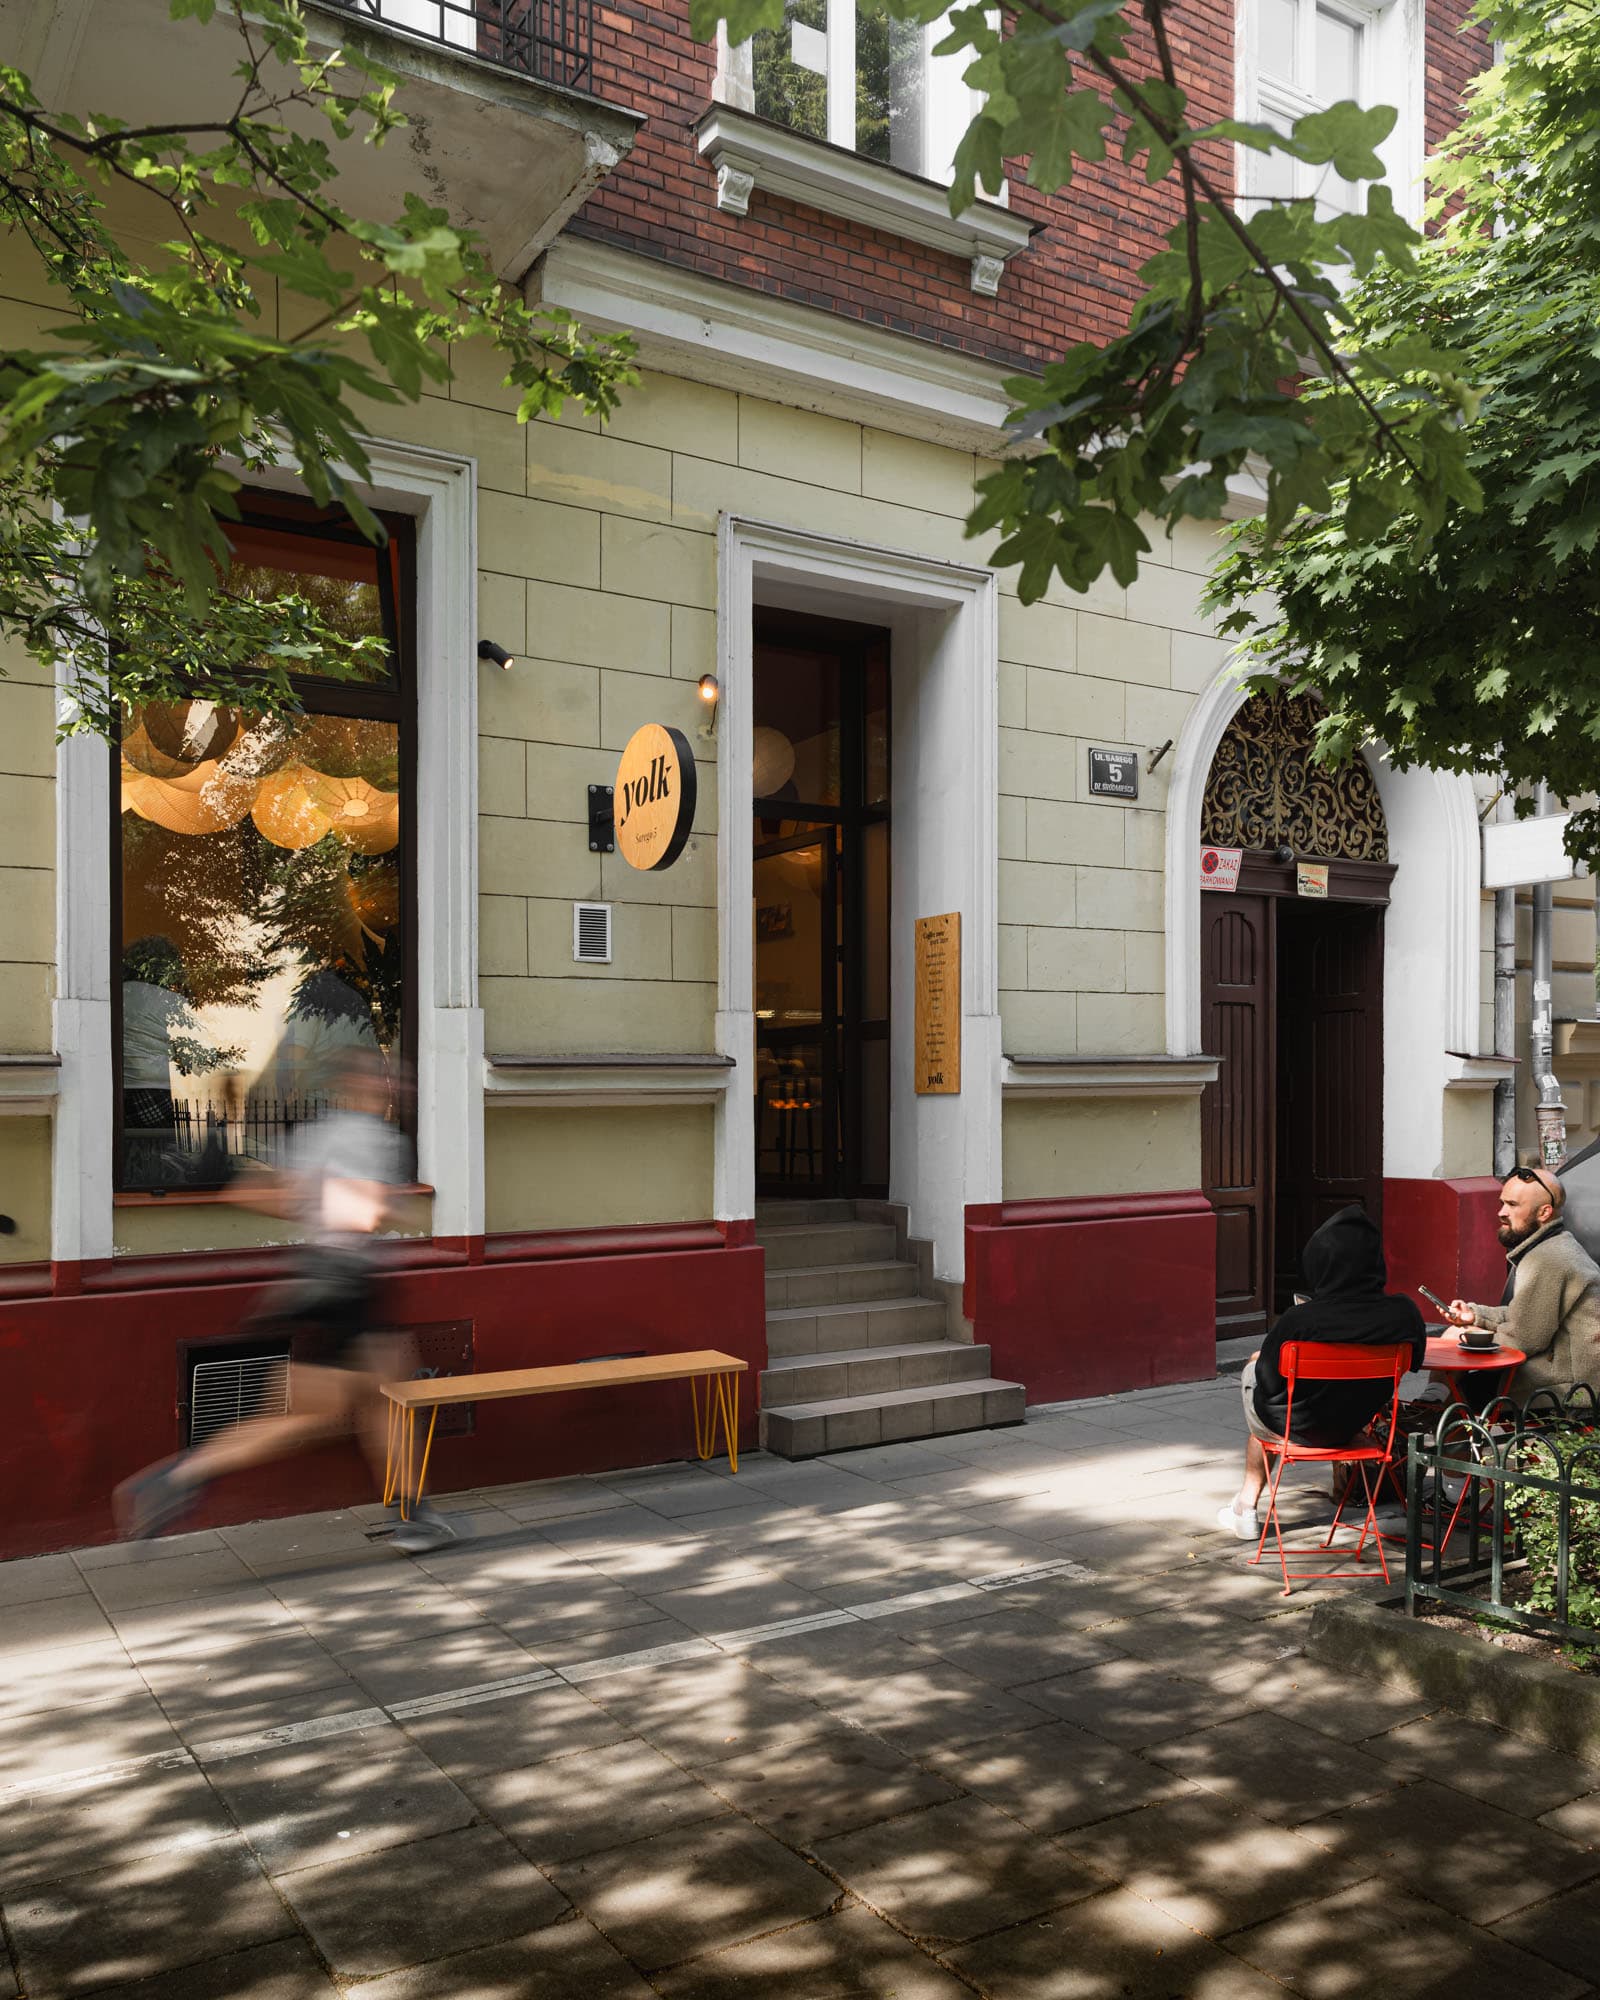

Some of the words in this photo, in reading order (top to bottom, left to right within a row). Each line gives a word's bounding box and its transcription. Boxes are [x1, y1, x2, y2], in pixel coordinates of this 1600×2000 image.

[1109, 763, 1123, 782] 5
[620, 754, 672, 827] yolk
[1218, 858, 1238, 871] ZAKAZ
[926, 1072, 944, 1088] yolk
